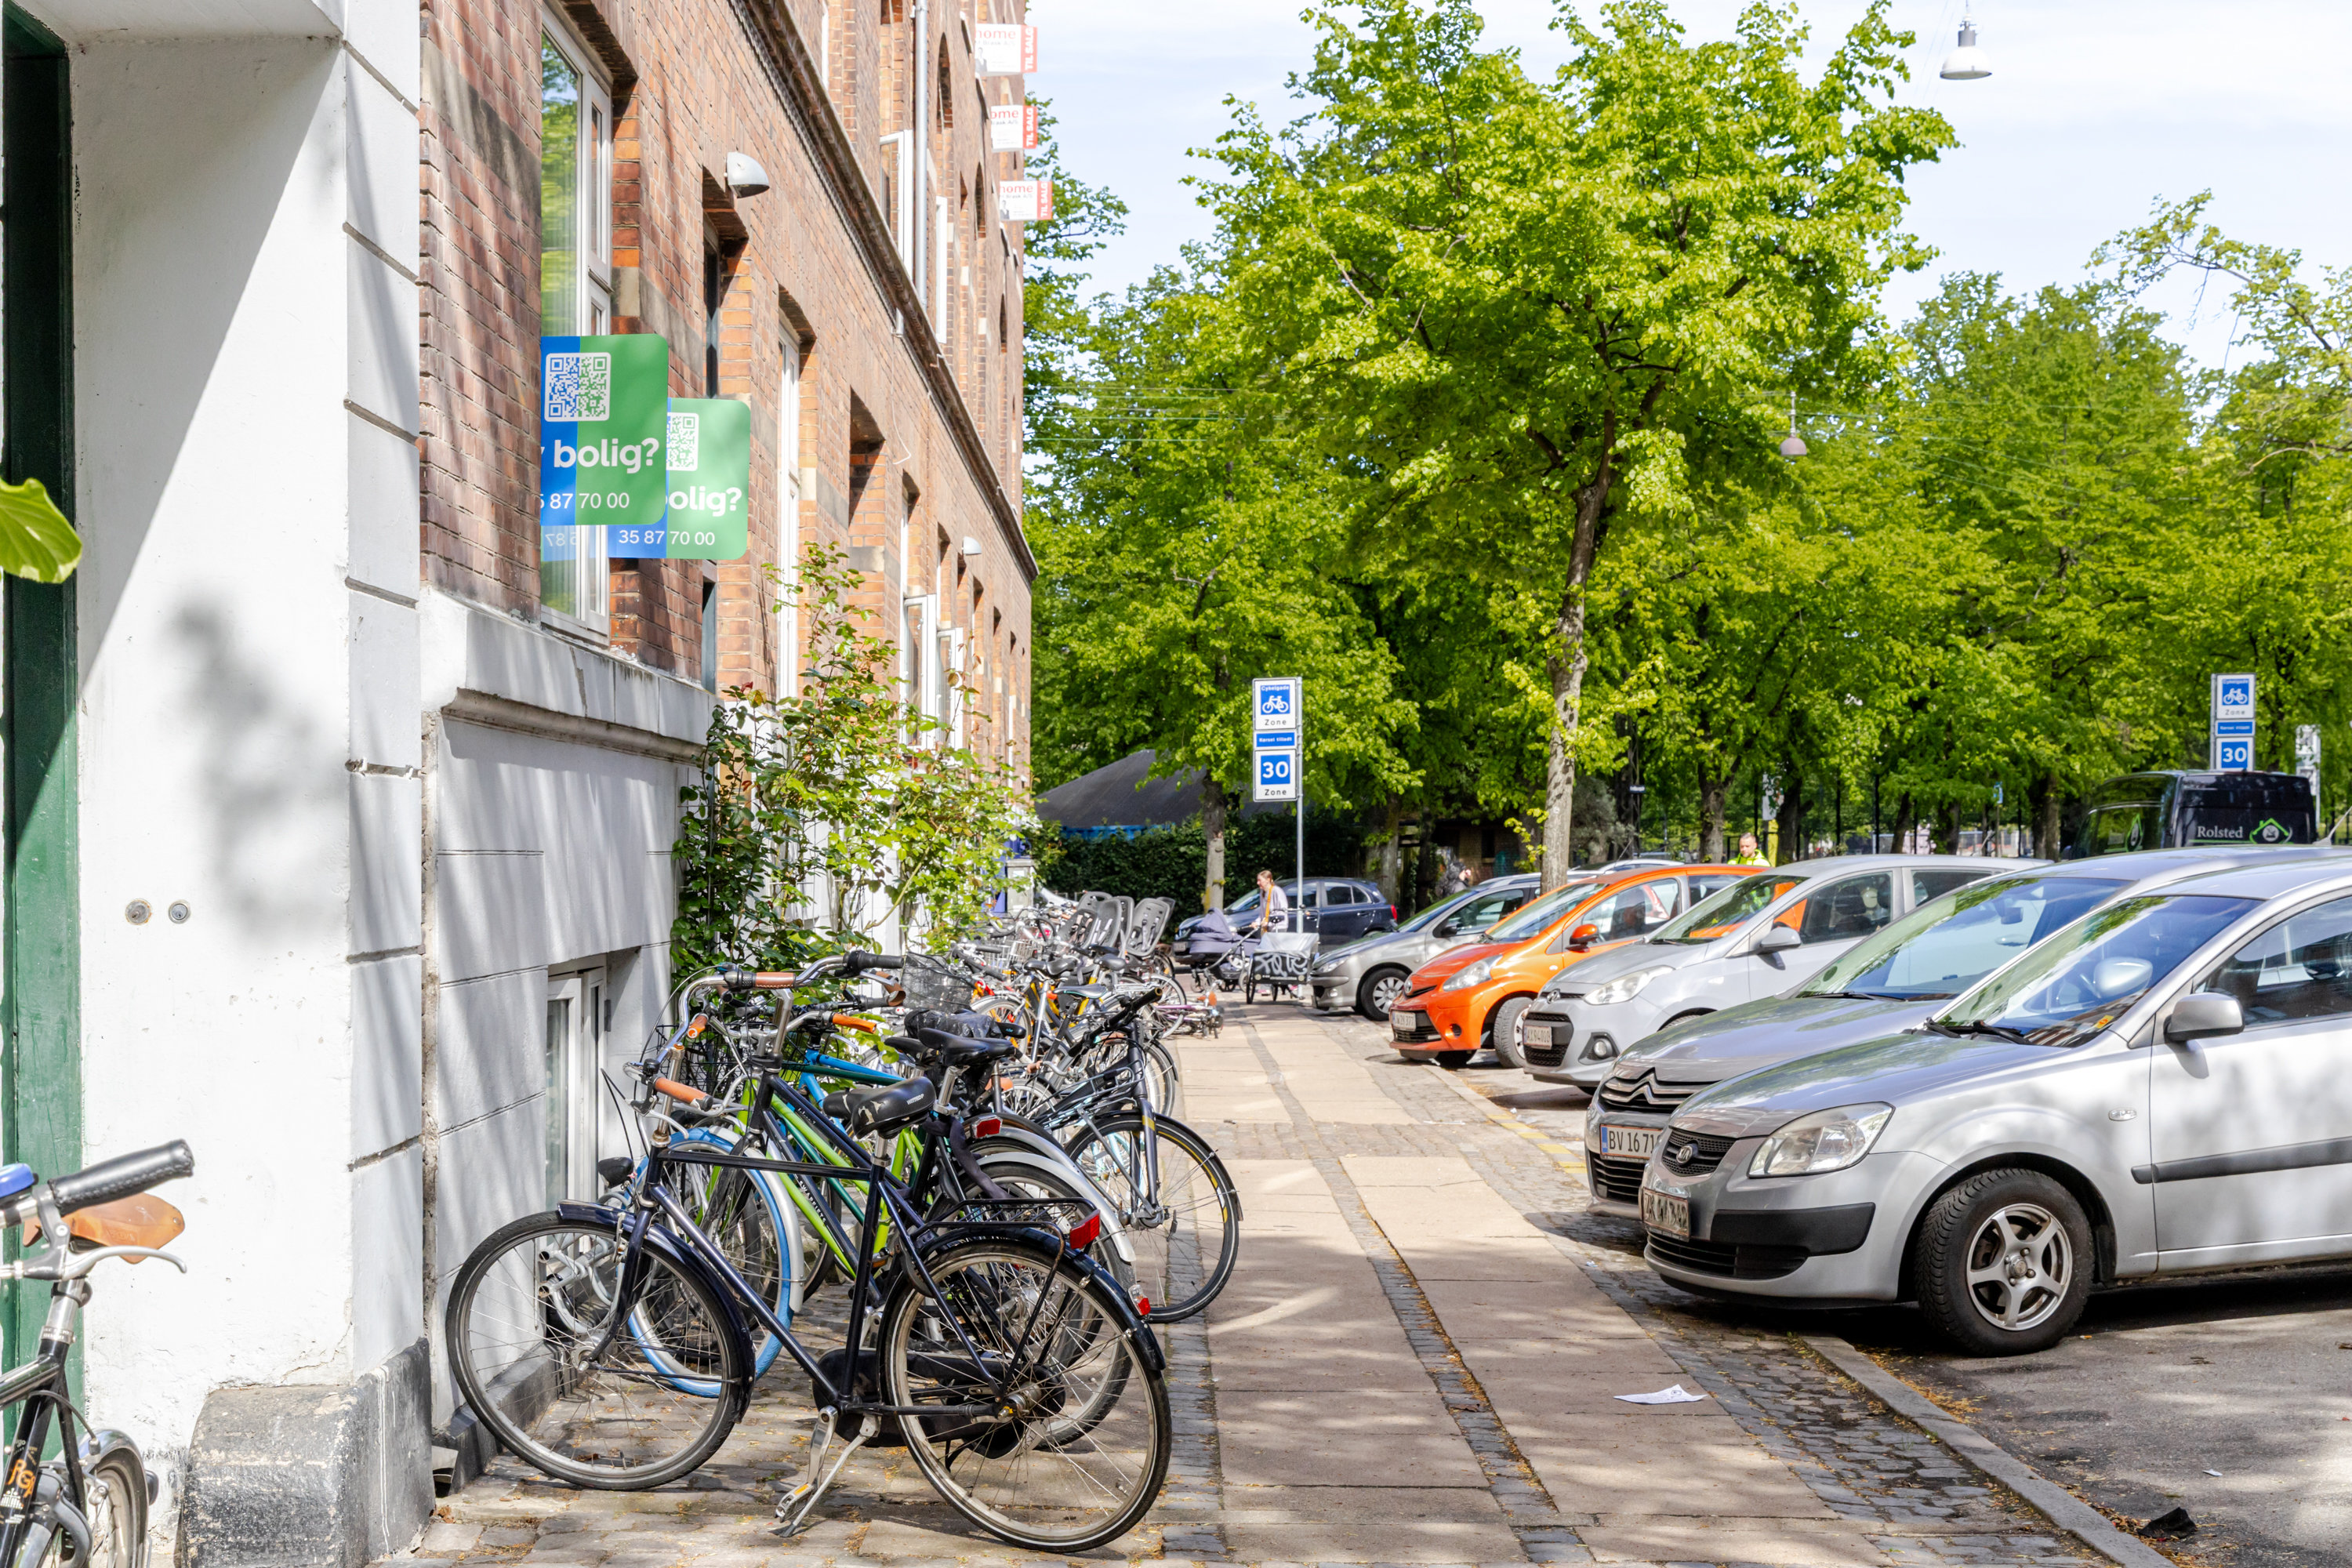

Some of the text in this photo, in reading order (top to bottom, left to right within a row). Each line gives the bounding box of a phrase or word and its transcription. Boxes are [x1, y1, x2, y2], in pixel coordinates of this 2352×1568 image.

[1025, 27, 1034, 71] TIL SALG
[990, 110, 1019, 119] ome
[554, 437, 659, 474] bolig?
[550, 493, 573, 509] 87
[579, 492, 601, 509] 70
[607, 492, 630, 509] 00
[665, 486, 742, 517] olig?
[619, 530, 715, 546] 35 87 70 00
[2223, 747, 2248, 763] 30
[1262, 760, 1289, 779] 30
[2198, 826, 2243, 838] Rolsted
[1609, 1131, 1661, 1154] BV 16 71
[799, 1180, 826, 1222] SWAPFIETS
